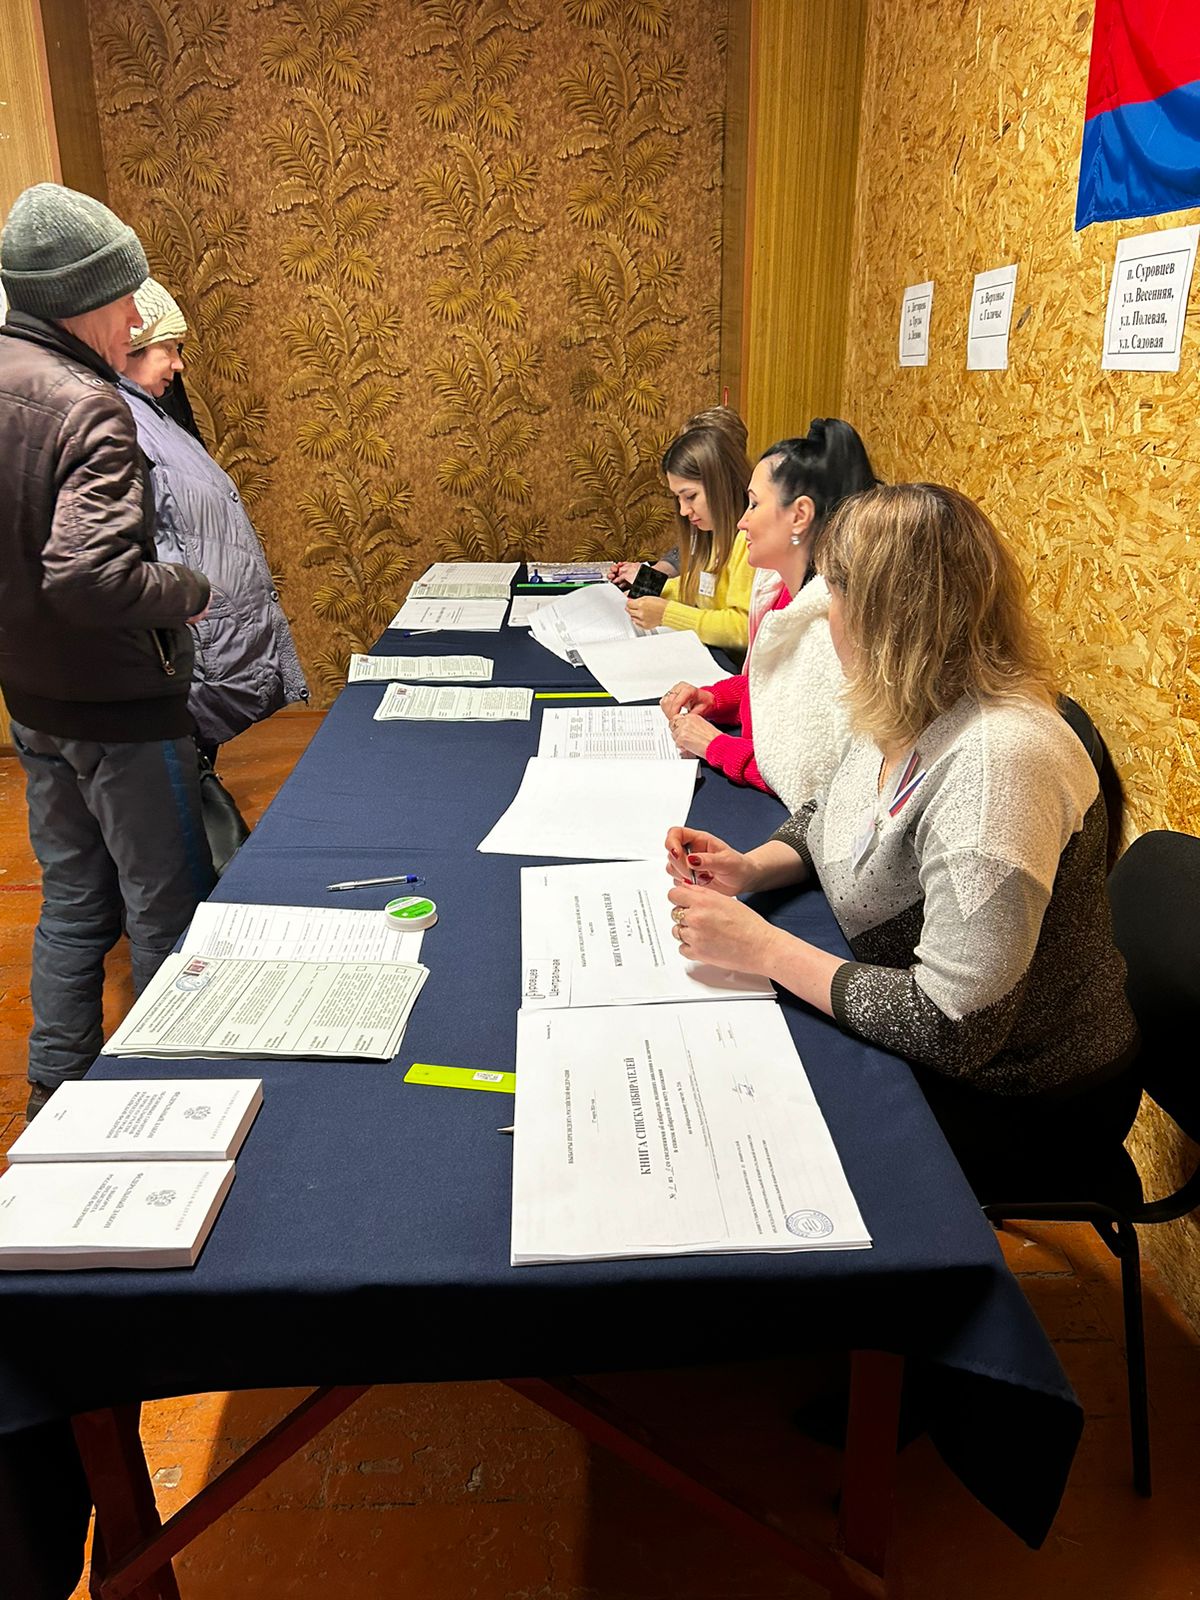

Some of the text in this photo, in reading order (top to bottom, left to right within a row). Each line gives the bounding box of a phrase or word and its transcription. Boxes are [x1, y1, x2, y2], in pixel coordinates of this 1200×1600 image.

[1127, 262, 1175, 282] п. Суровцев
[1121, 287, 1174, 308] ул. Весенняя,
[1119, 310, 1168, 331] ул. Полевая,
[1117, 334, 1164, 354] ул. Садовая
[548, 958, 562, 997] Центральная
[624, 1056, 653, 1175] КНИГА СПИСКА ИЗБИРАТЕЛЕЙ
